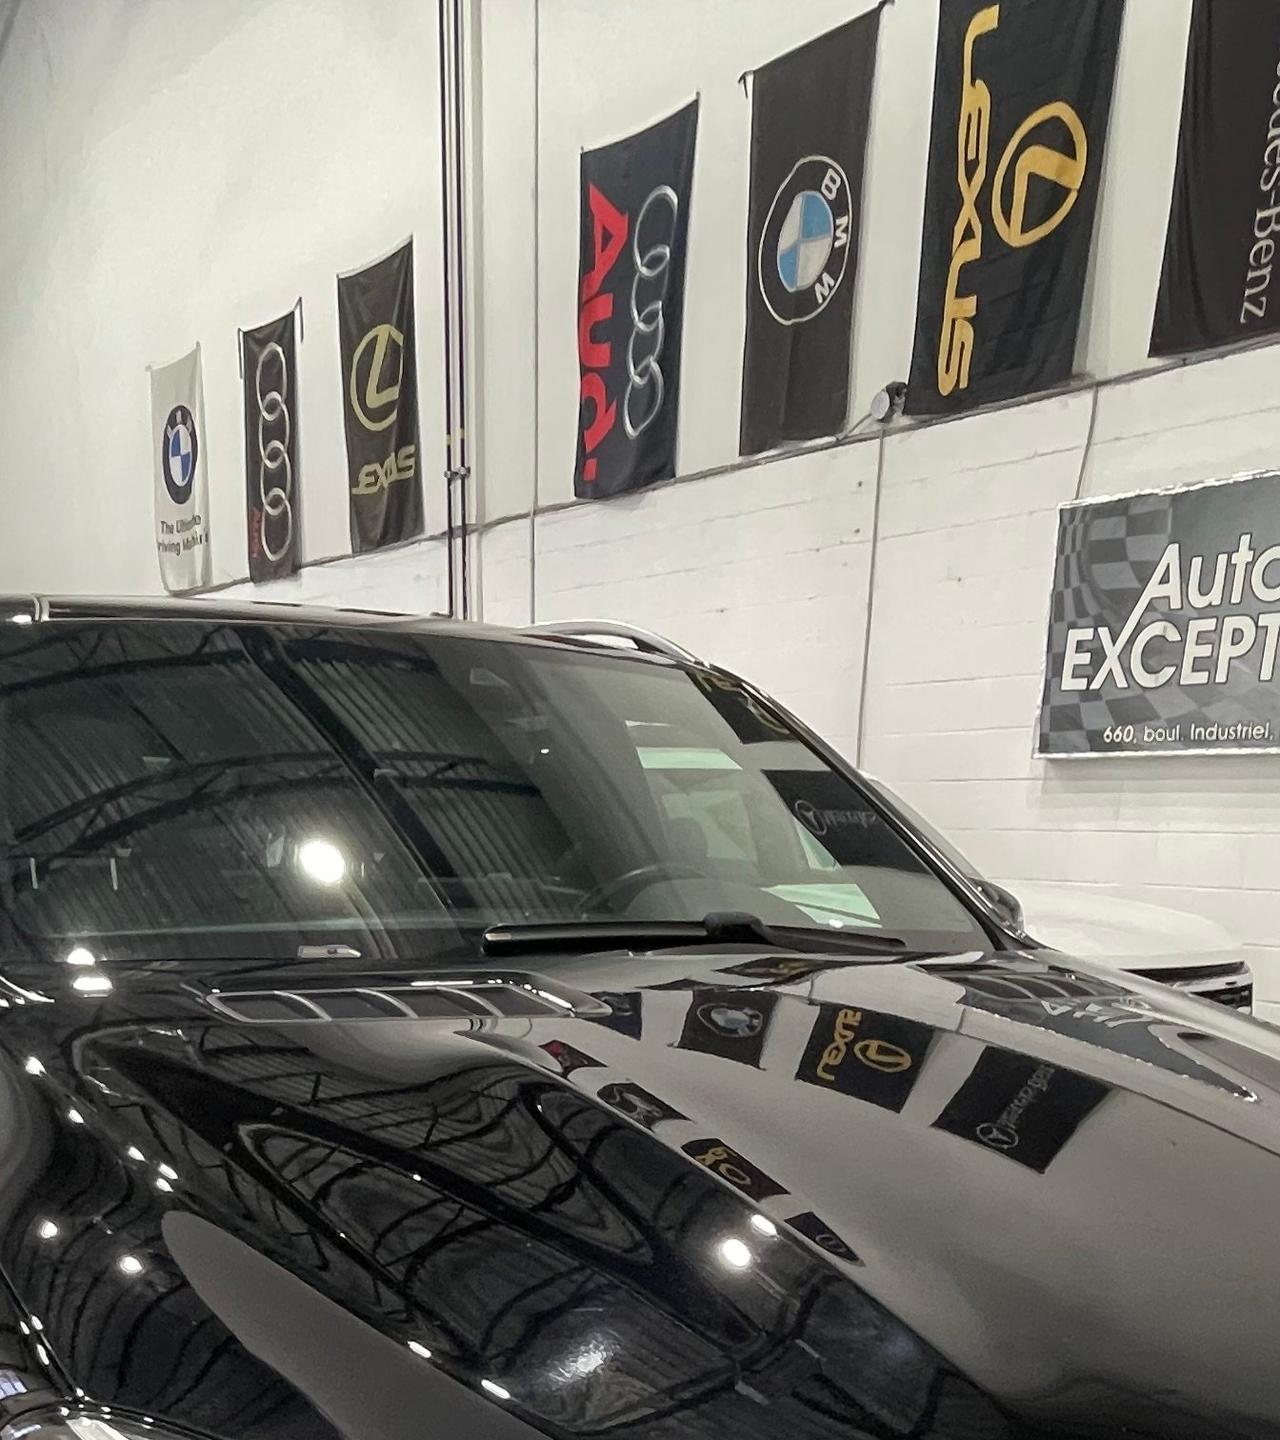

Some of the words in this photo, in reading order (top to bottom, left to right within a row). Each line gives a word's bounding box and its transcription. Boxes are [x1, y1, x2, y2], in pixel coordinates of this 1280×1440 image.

[937, 4, 1000, 396] LEXUS
[1102, 724, 1137, 744] 660,
[1143, 723, 1184, 742] boul.
[1190, 721, 1273, 742] Industriel,
